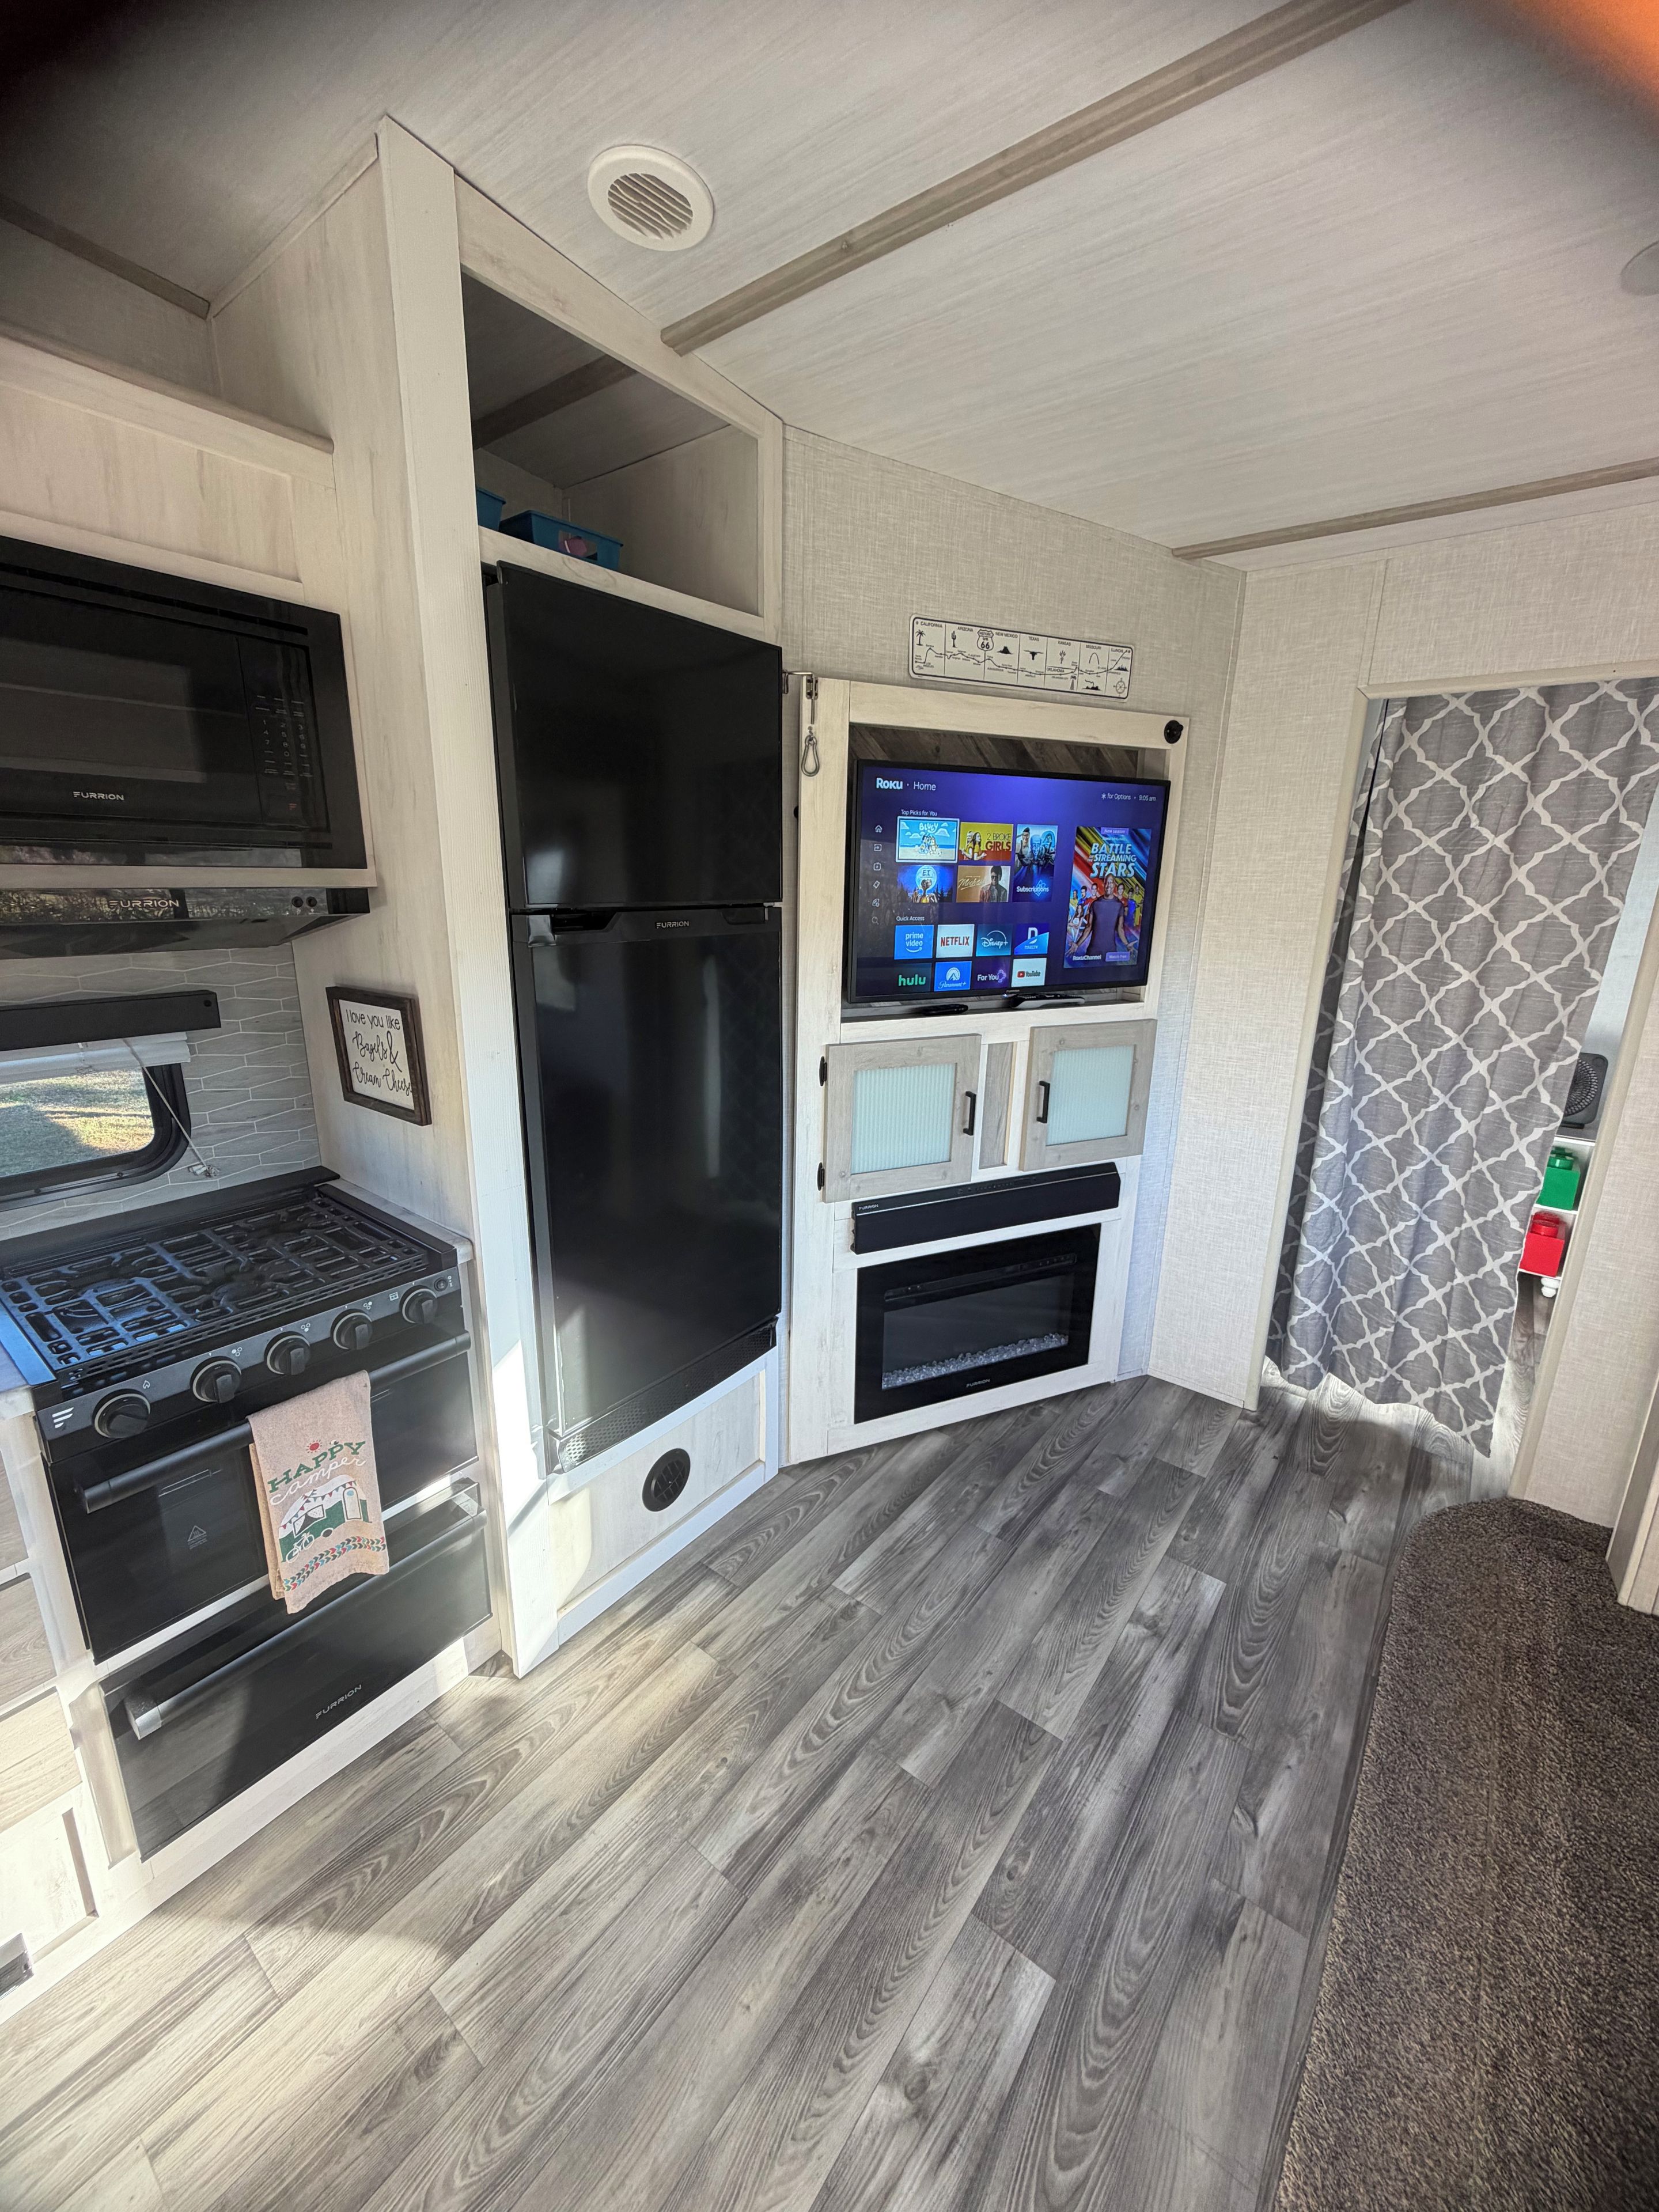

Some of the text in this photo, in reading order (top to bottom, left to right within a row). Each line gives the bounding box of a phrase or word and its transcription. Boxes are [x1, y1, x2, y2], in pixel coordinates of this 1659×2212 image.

[980, 641, 990, 649] 66
[914, 781, 936, 791] Home
[73, 791, 125, 801] FURRION
[993, 833, 1012, 841] BROKE
[986, 841, 1011, 851] GIRLS
[1091, 843, 1132, 854] BATTLE
[1094, 854, 1137, 862] STREAMING
[1090, 862, 1135, 878] STARS
[108, 900, 180, 908] FURRION
[656, 921, 690, 929] FURRION
[906, 932, 923, 940] prime
[940, 936, 969, 947] NETFLIX
[1026, 970, 1041, 978] YouTube
[898, 975, 926, 986] hulu
[349, 1009, 366, 1025] love
[367, 1014, 384, 1029] you
[385, 1014, 401, 1030] like
[352, 1031, 402, 1073] Bagels &
[353, 1062, 381, 1088] Cream
[267, 1441, 366, 1493] HAPPY
[270, 1456, 367, 1506] camper
[315, 1684, 362, 1719] FURRION
